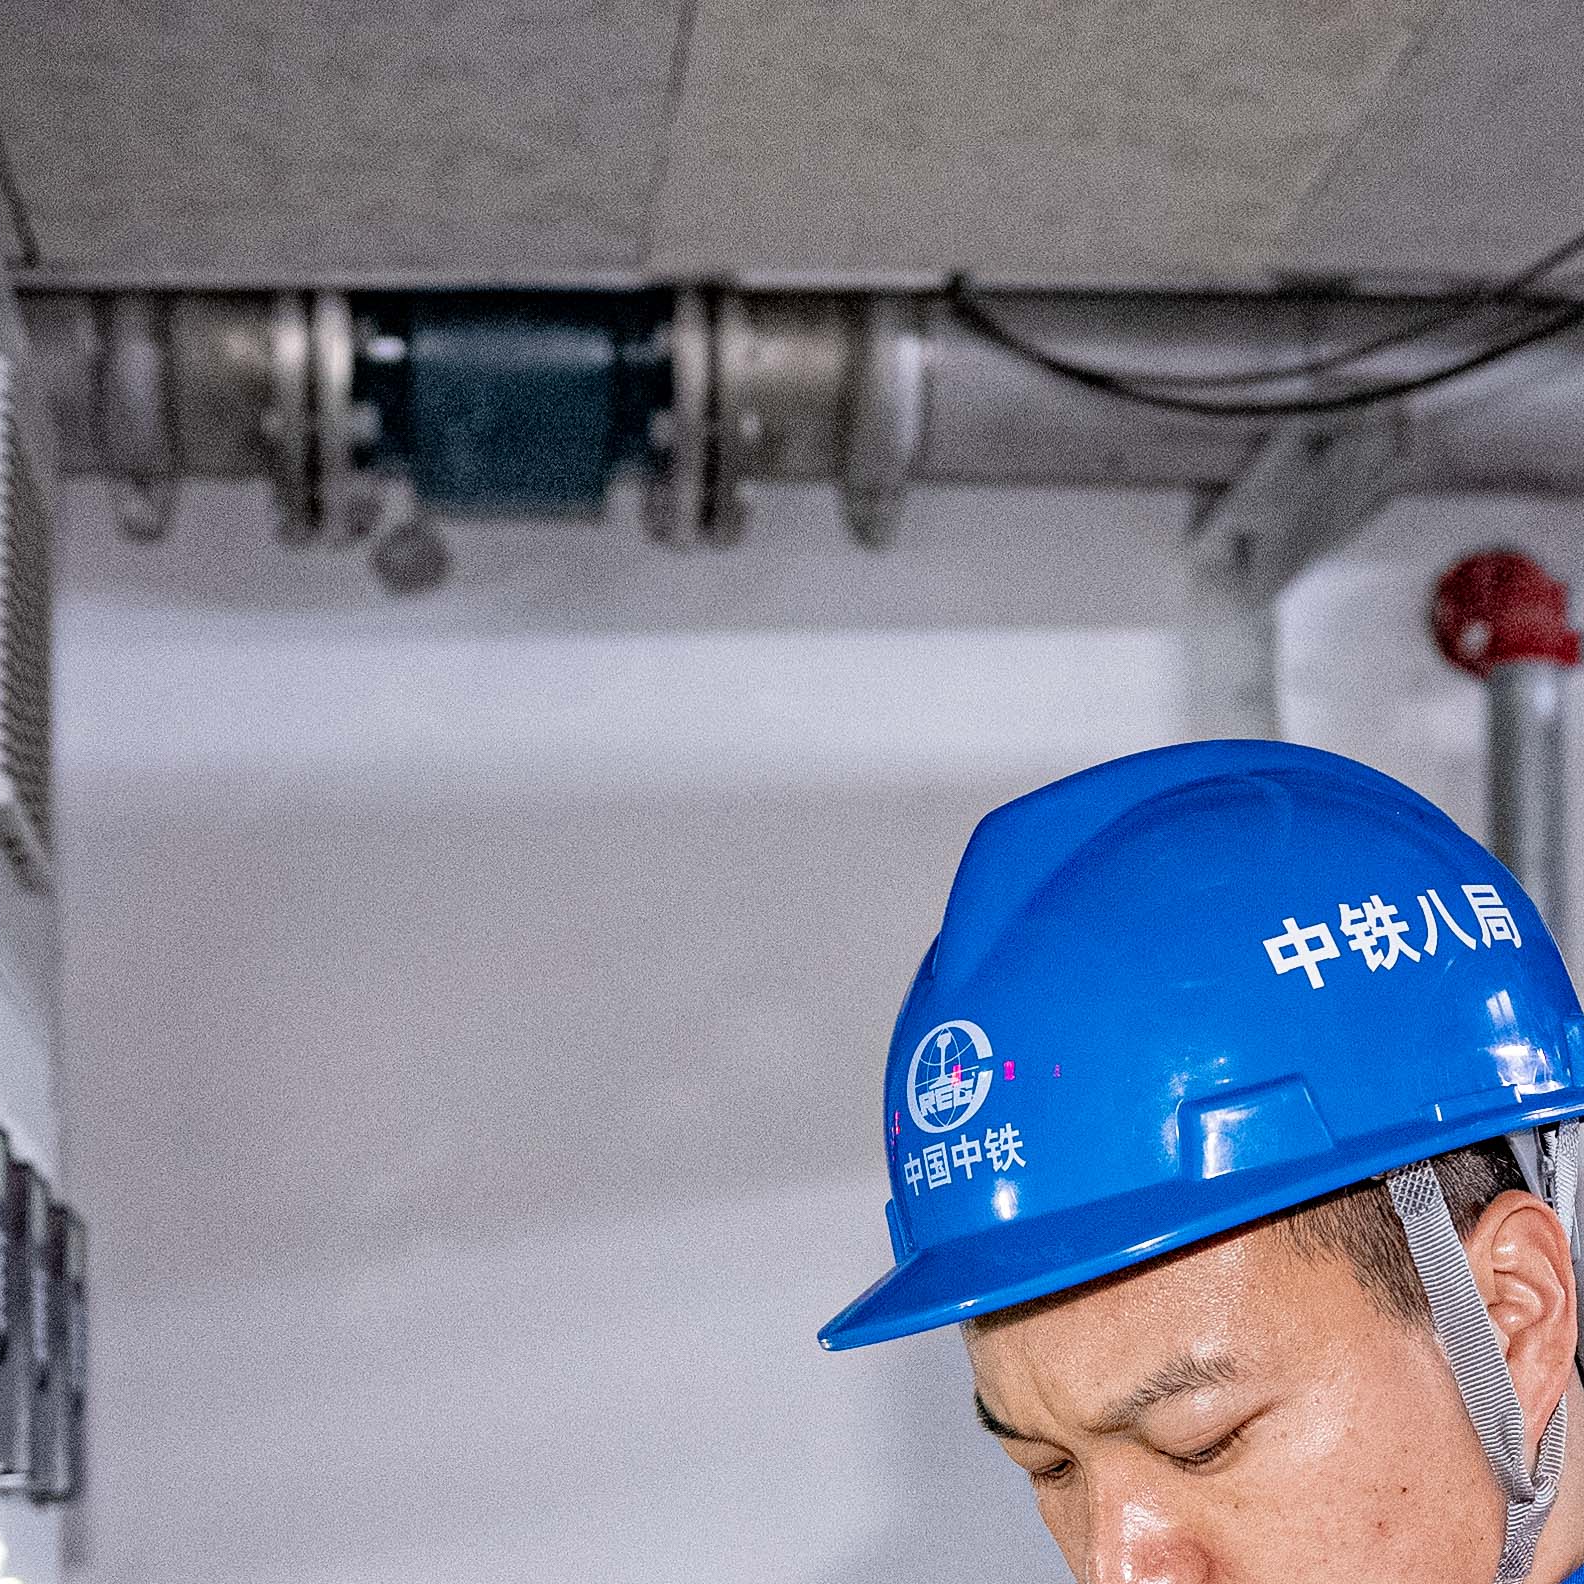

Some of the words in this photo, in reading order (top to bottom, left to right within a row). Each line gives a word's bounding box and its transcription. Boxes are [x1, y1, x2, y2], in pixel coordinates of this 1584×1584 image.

[1262, 884, 1522, 990] 中铁八局
[903, 1122, 1027, 1197] 中国中铁
